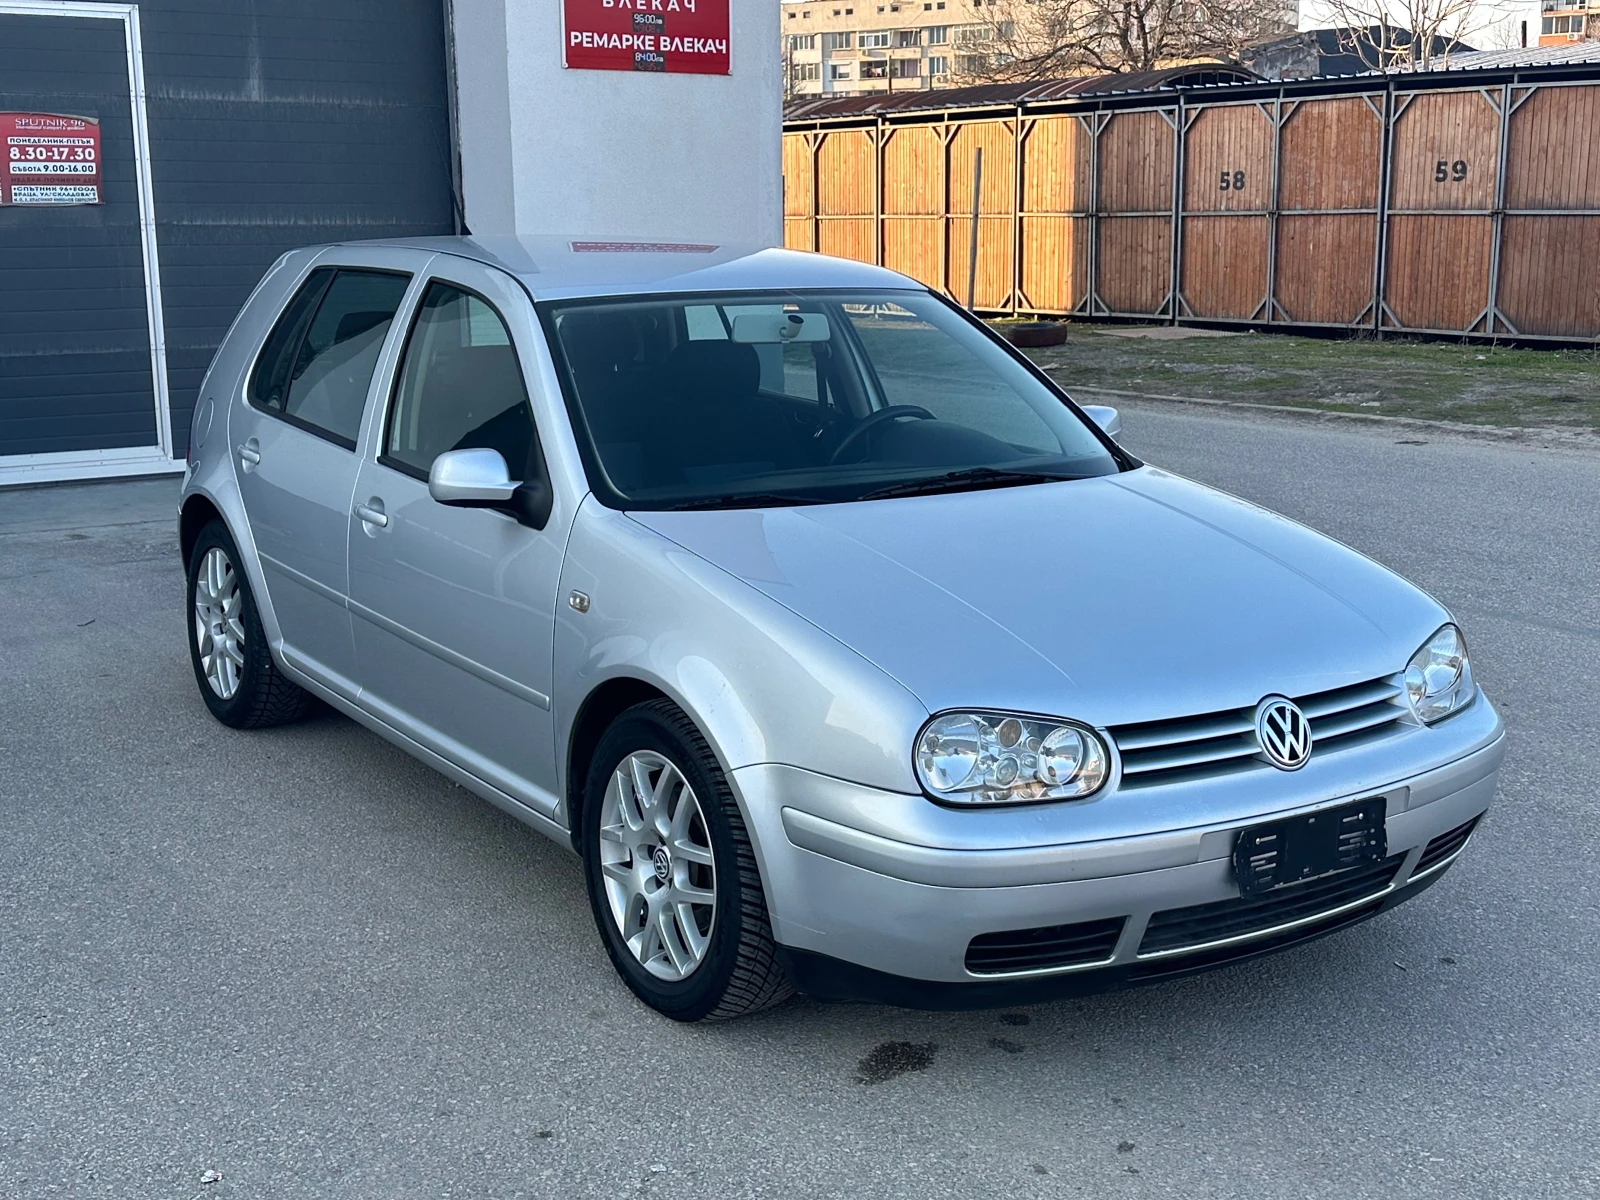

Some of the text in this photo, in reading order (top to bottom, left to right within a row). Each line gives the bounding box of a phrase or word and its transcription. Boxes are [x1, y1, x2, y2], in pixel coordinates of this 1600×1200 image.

[570, 31, 727, 54] РЕМАРКЕ ВЛЕКАЧ
[15, 118, 85, 127] SPUTNIK 96
[9, 137, 92, 145] ПОНЕДЕЛНИК-ПЕТЪК
[9, 147, 96, 160] 8.30-17.30
[43, 165, 94, 173] 9.00-16.00
[1434, 159, 1468, 183] 59
[1219, 170, 1246, 192] 58
